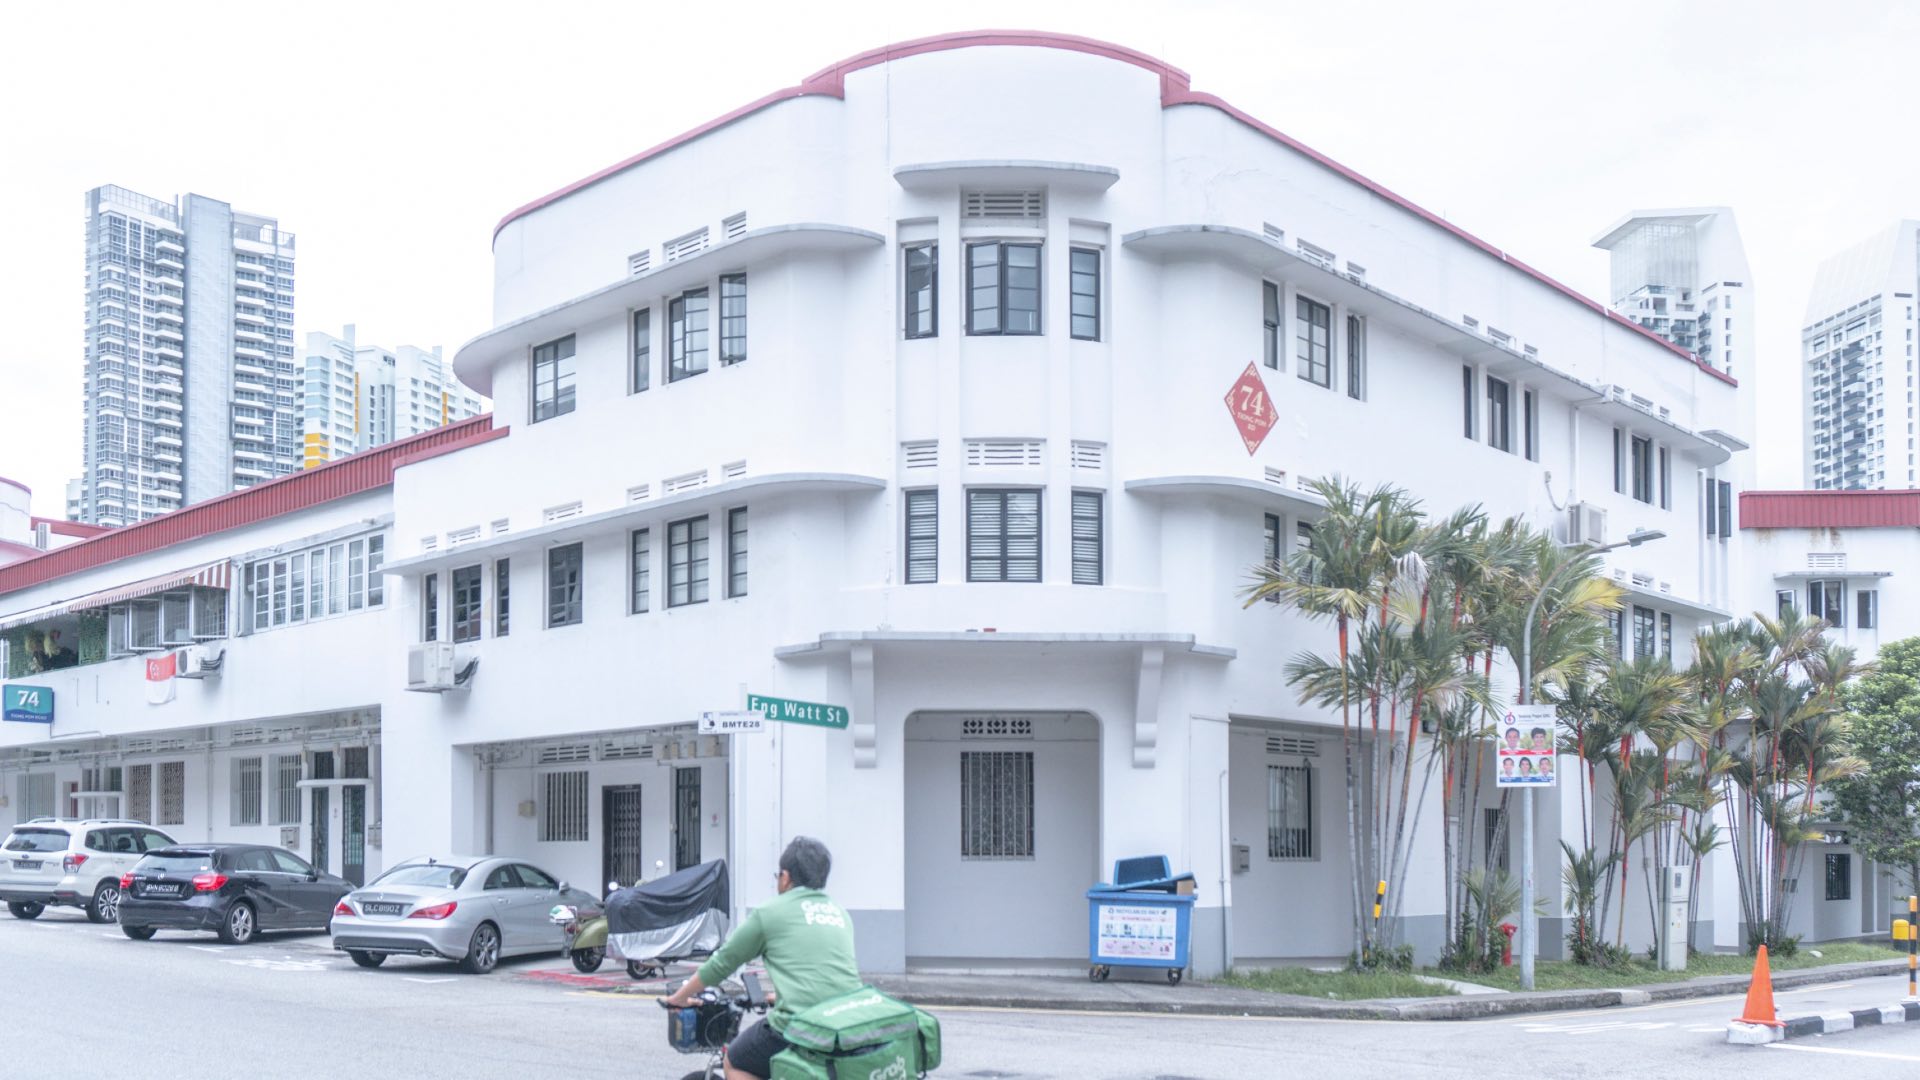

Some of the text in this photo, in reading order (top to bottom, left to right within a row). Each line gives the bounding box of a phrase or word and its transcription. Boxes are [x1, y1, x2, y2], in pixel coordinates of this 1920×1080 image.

[1241, 385, 1264, 417] 74
[17, 690, 40, 707] 74
[751, 697, 841, 723] Eng Watt St
[800, 900, 841, 915] Grab
[805, 912, 845, 928] Food
[869, 1055, 906, 1080] Grab
